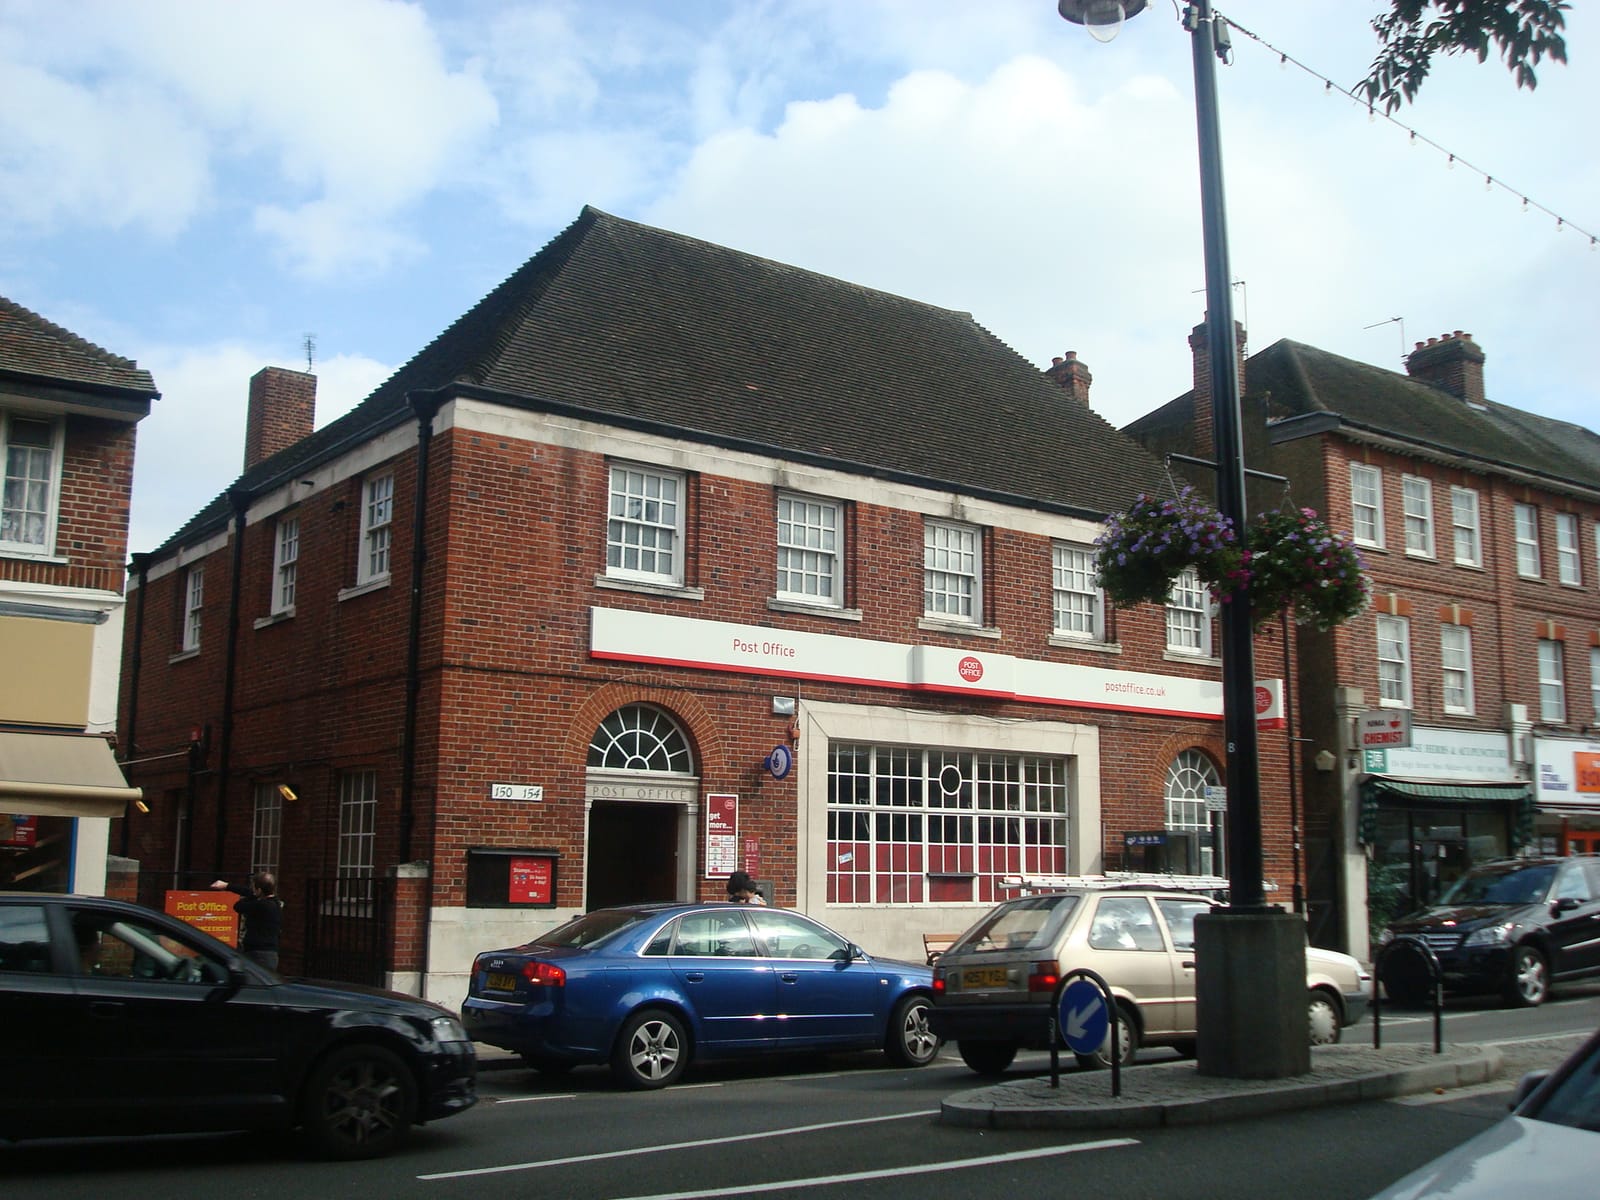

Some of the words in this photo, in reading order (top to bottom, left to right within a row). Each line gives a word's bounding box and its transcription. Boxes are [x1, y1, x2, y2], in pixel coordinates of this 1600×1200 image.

[733, 638, 758, 654] Post
[762, 641, 795, 658] Office
[963, 661, 979, 669] POST
[960, 668, 981, 677] OFFICE
[1105, 682, 1166, 696] postoffice.co.uk
[1364, 731, 1404, 744] CHEMIST
[494, 786, 513, 798] 150
[523, 788, 541, 799] 154
[592, 786, 625, 797] POST
[637, 788, 687, 801] OFFICE
[709, 812, 721, 821] get
[177, 902, 197, 911] Post
[199, 903, 227, 911] Office
